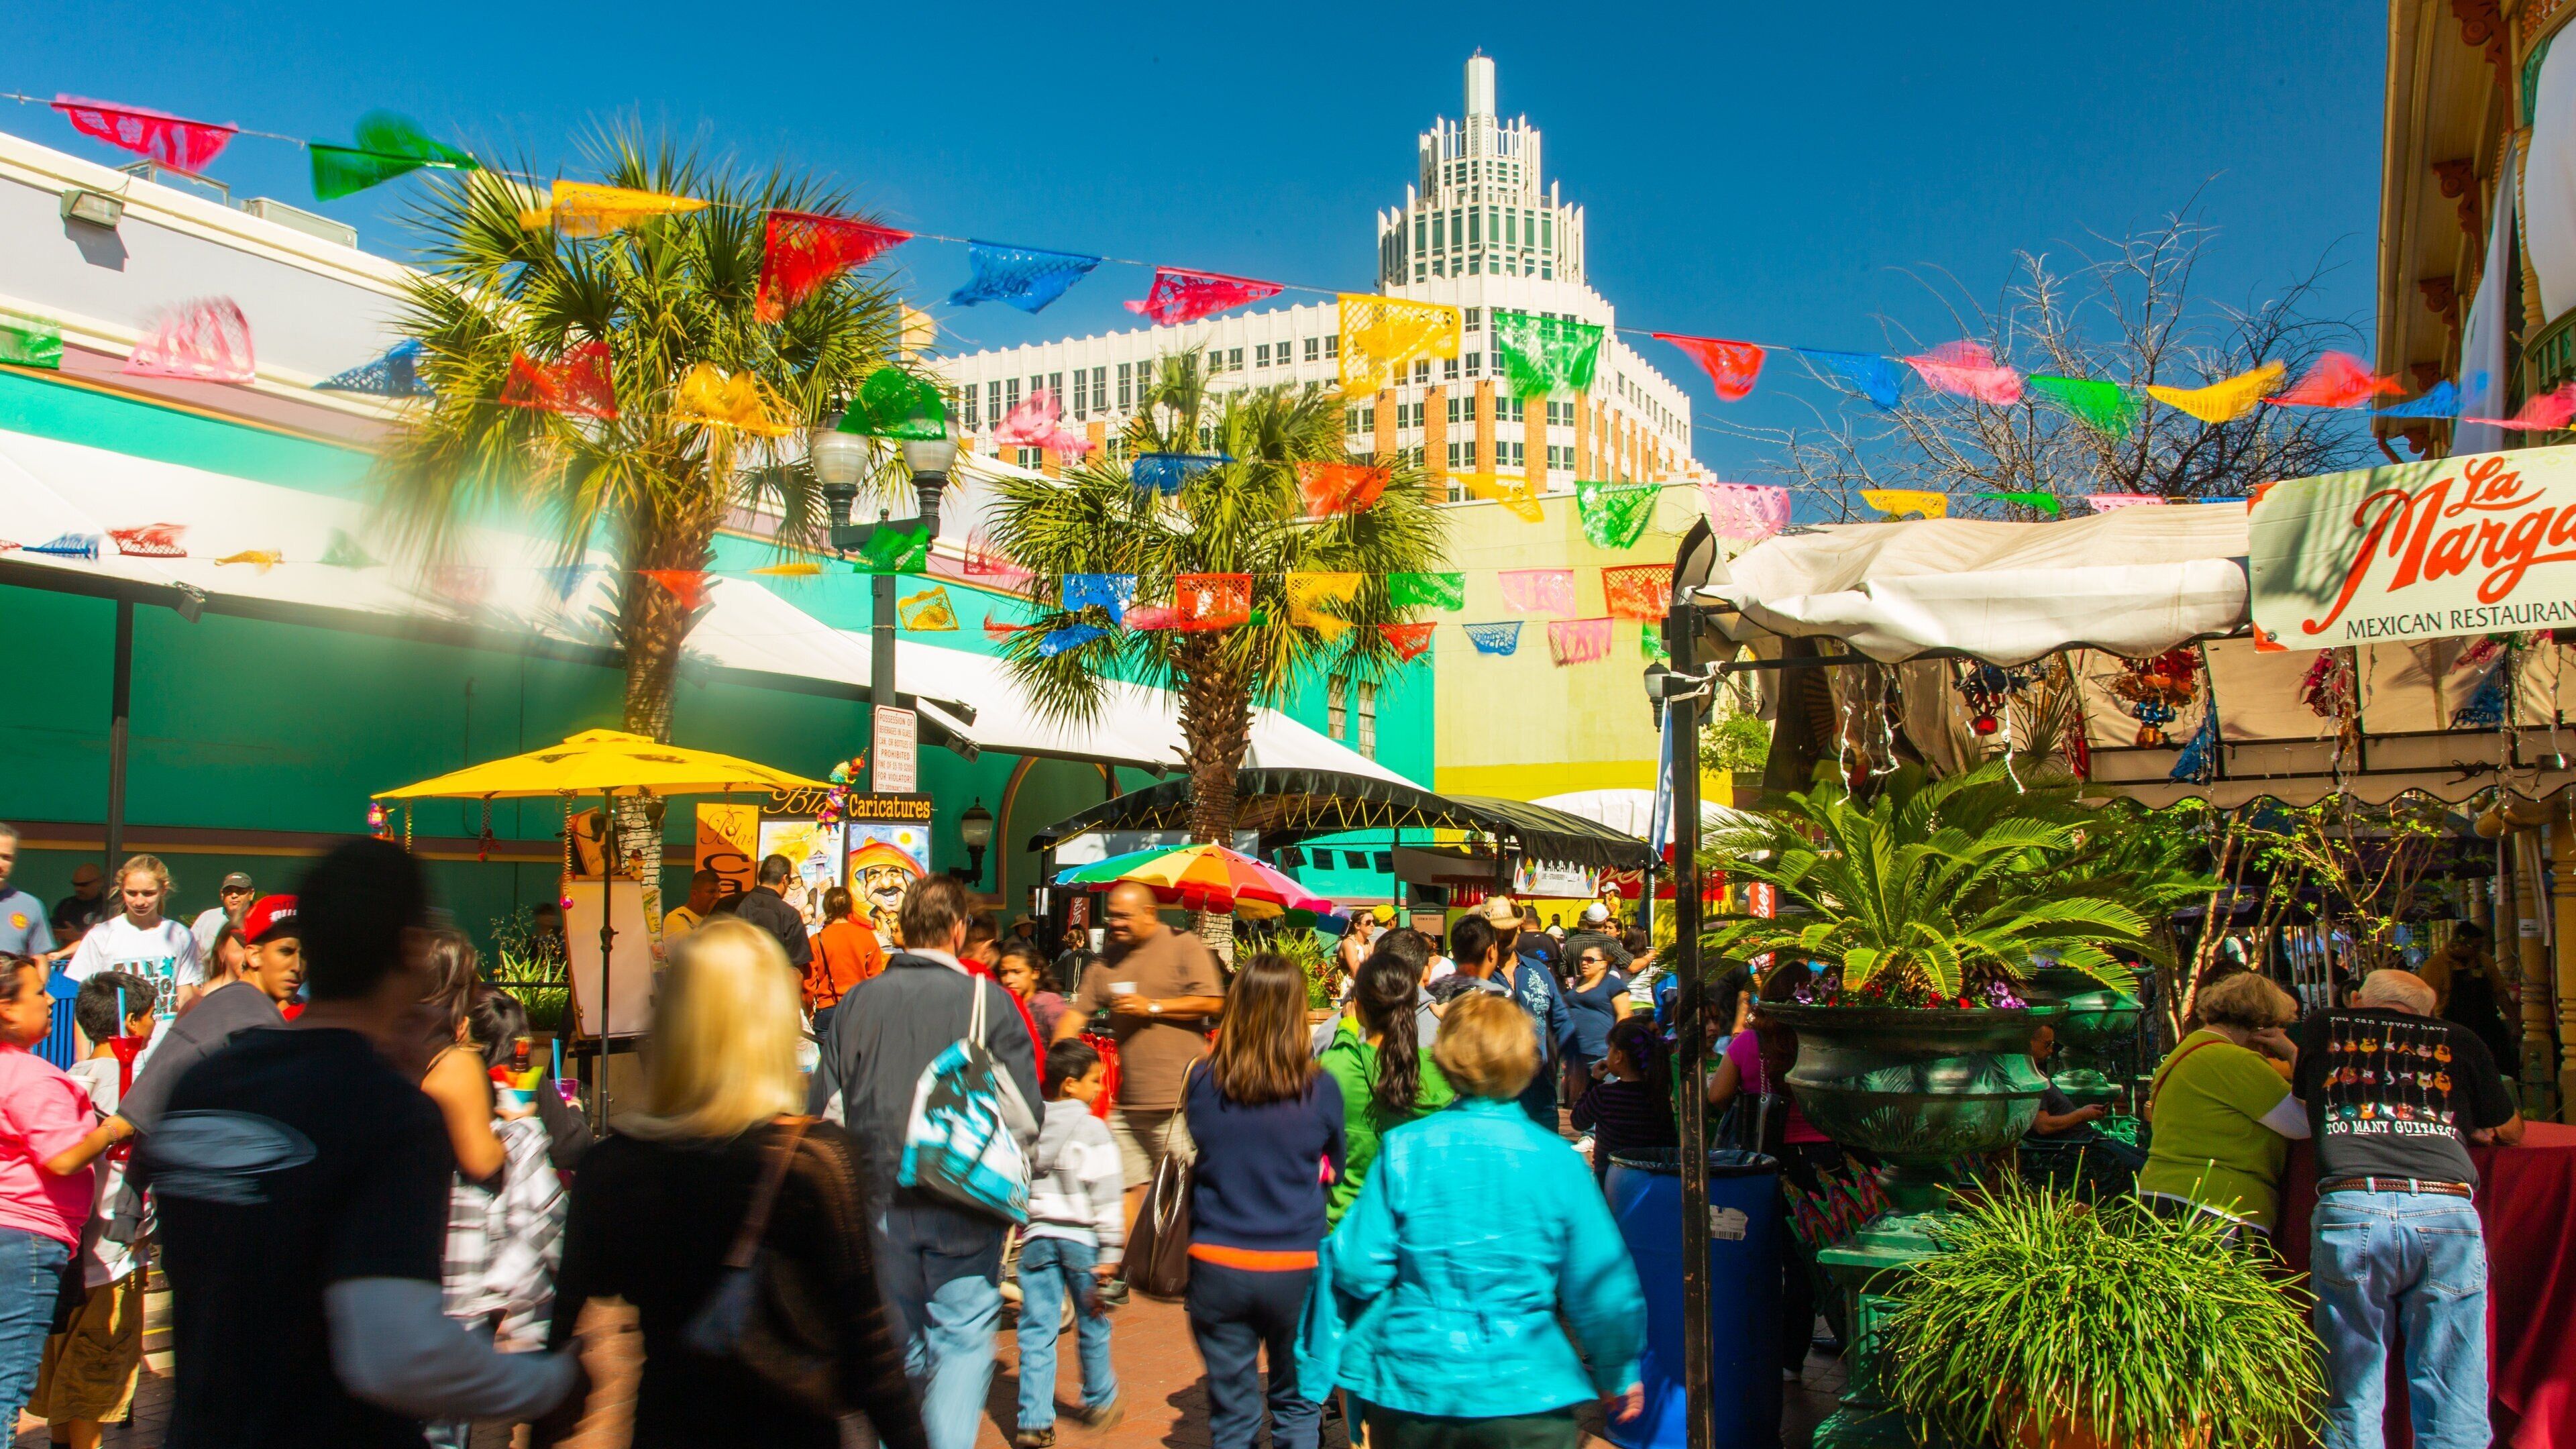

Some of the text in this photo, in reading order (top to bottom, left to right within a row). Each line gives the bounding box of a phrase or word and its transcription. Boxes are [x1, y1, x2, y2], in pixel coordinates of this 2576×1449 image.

[2444, 456, 2546, 518] La
[2347, 612, 2442, 640] MEXICAN
[879, 714, 913, 727] POSSESSION OF
[879, 725, 897, 736] BEVERAGES
[894, 739, 908, 749] BOTTLES
[881, 749, 910, 760] PROHIBITED
[877, 771, 912, 784] FOR VIOLATORS
[849, 794, 930, 818] Caricatures
[2381, 1020, 2415, 1029] never
[2420, 1024, 2448, 1032] have
[2326, 1122, 2348, 1134] TOO
[2353, 1121, 2389, 1134] MANY
